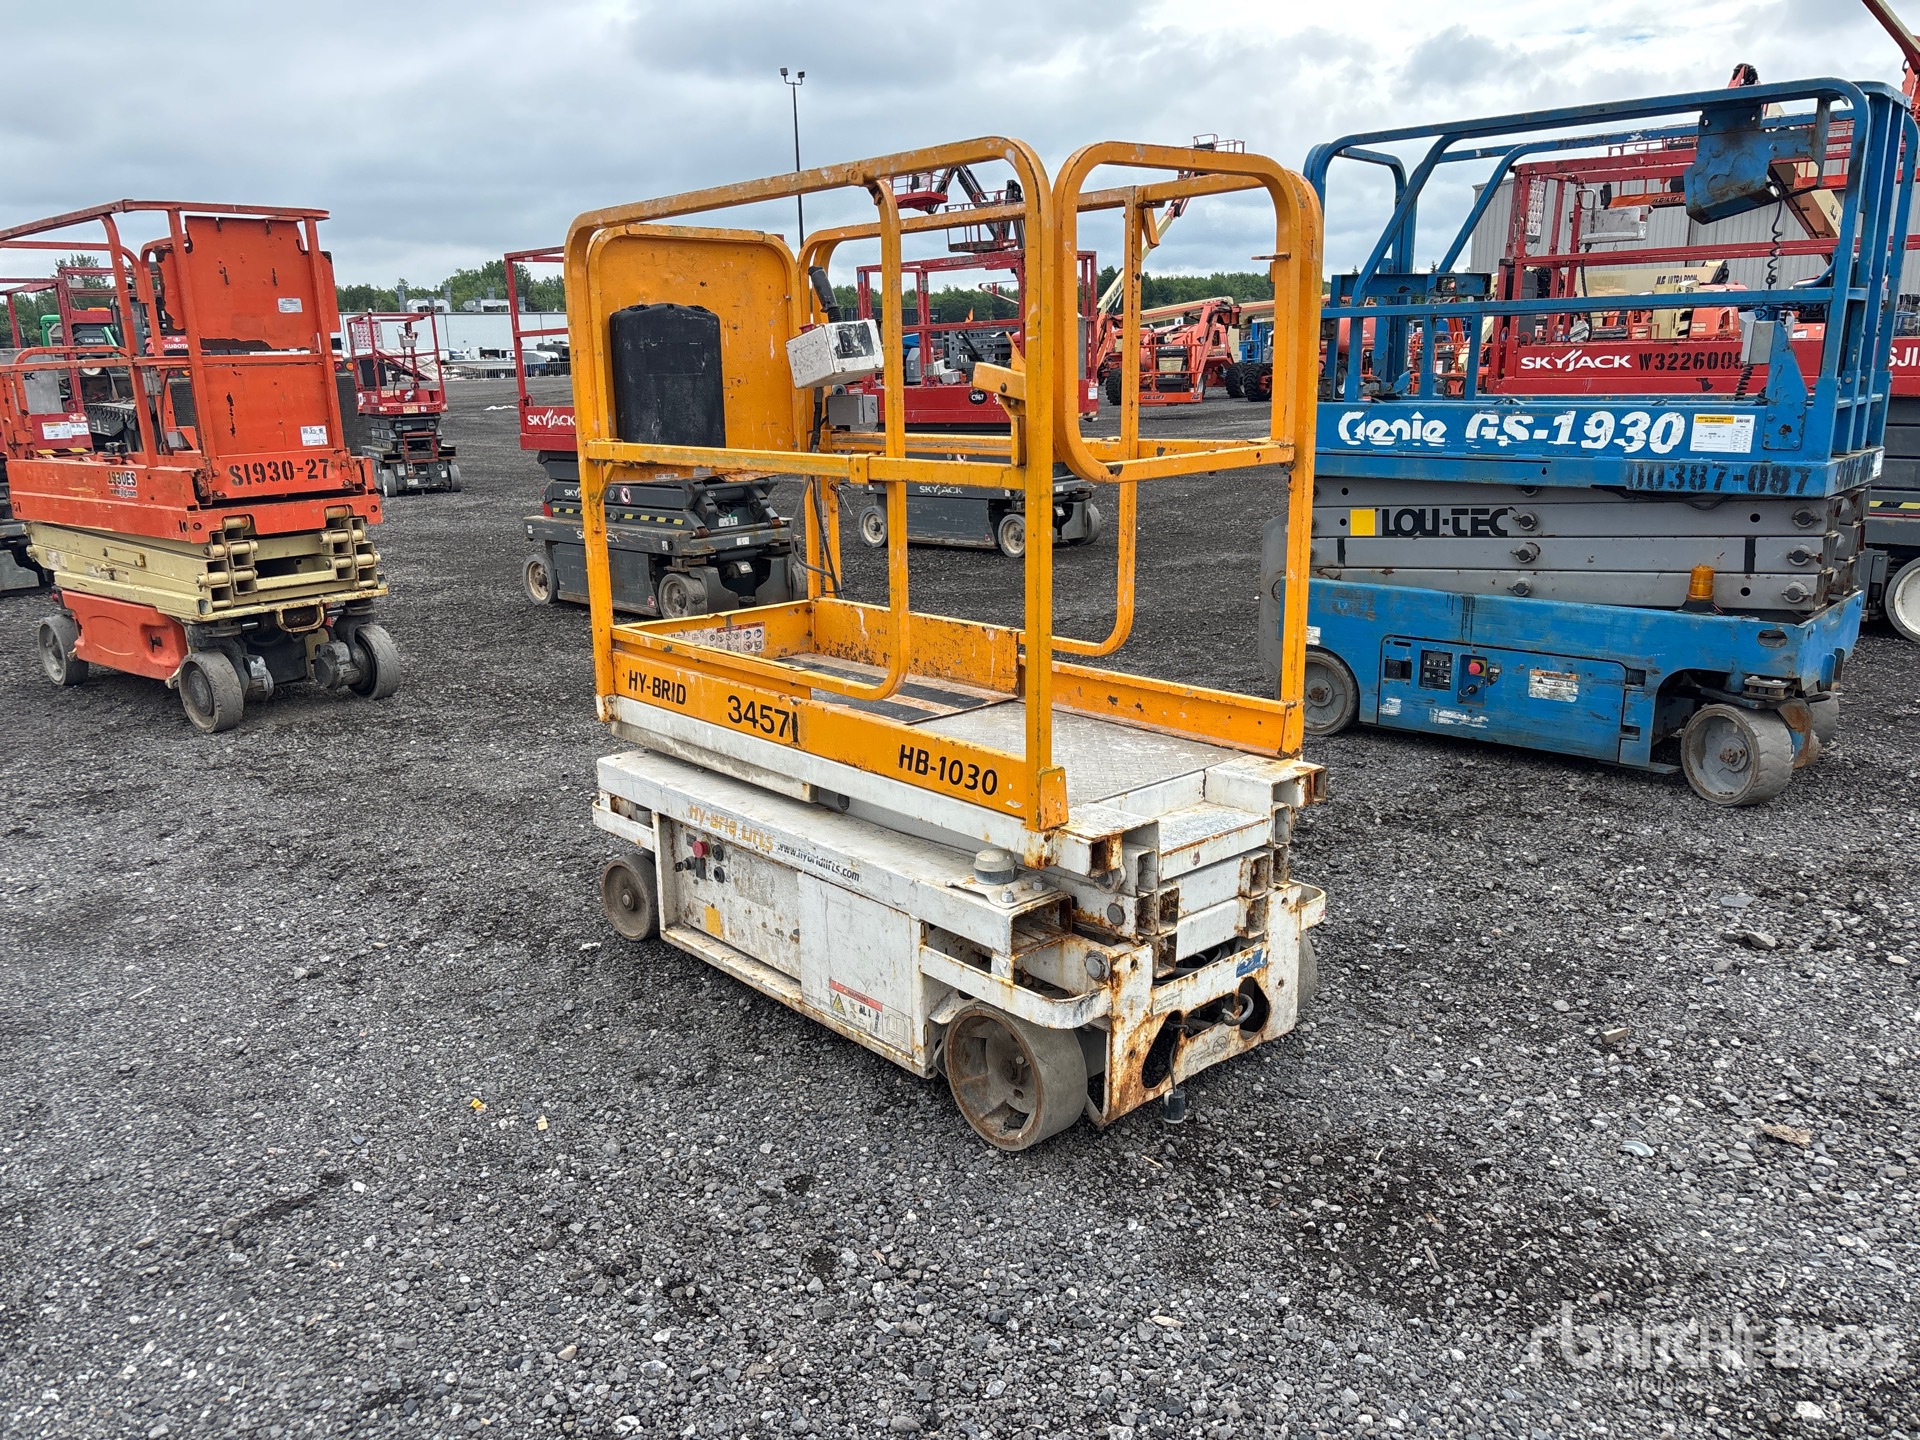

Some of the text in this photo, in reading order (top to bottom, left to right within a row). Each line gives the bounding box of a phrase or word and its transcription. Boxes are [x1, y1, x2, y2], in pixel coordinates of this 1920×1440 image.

[1520, 348, 1632, 372] SKYJACK
[1889, 346, 1920, 367] SJI
[527, 408, 576, 429] SKYJACK
[1338, 411, 1448, 446] Genie
[1465, 410, 1686, 454] GS-1930
[107, 471, 137, 487] 1930ES
[229, 458, 329, 486] S1930-27
[919, 484, 963, 495] SKYJACK
[628, 669, 687, 705] HY-BRID
[898, 743, 998, 796] HB-1030
